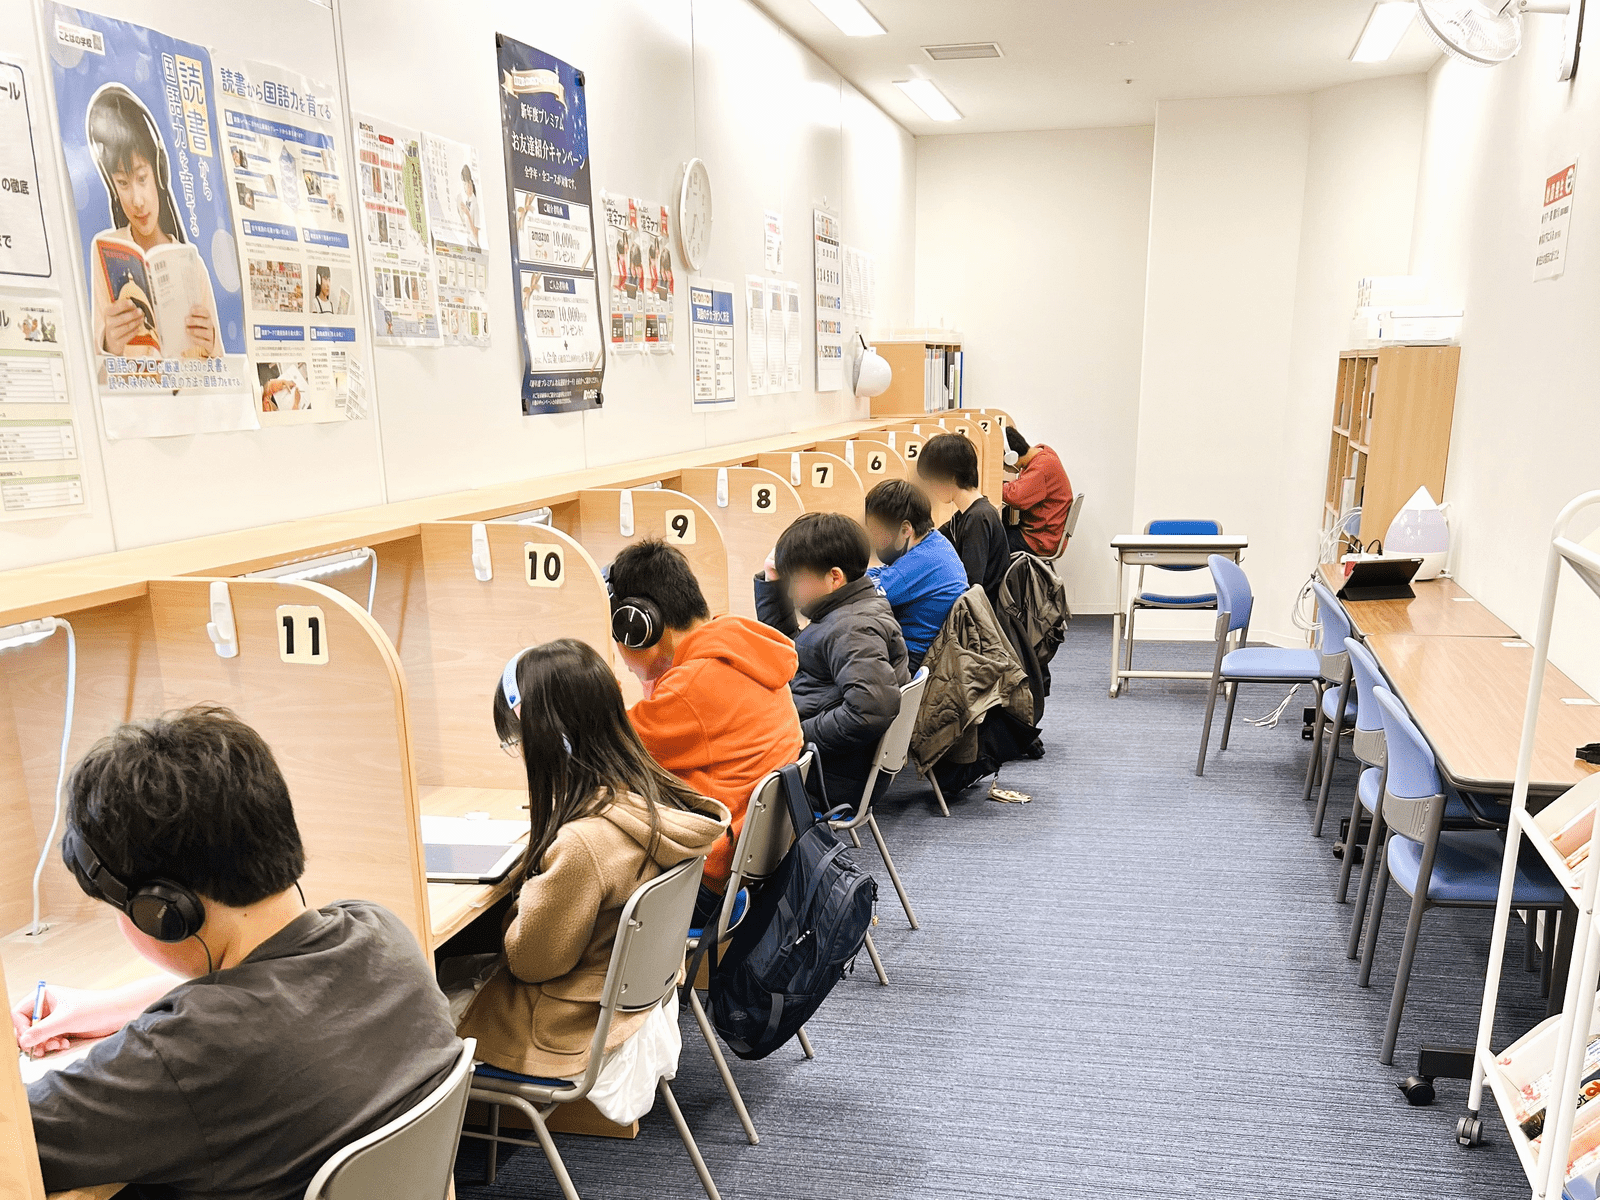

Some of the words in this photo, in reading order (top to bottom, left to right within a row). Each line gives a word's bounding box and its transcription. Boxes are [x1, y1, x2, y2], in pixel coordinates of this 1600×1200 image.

[220, 67, 332, 120] 読書から国語力を育てる
[520, 102, 565, 132] 新年度プレミアム
[161, 53, 200, 238] 国語力を育てる
[511, 131, 586, 170] お友達紹介キャンペーン
[2, 178, 30, 195] の徹底
[0, 235, 12, 249] で
[531, 231, 549, 243] amazon
[536, 308, 555, 319] amazon
[981, 422, 988, 432] 2
[908, 445, 918, 458] 5
[870, 455, 882, 471] 6
[816, 467, 829, 484] 7
[756, 488, 771, 509] 8
[671, 515, 689, 539] 9
[528, 550, 561, 581] 10
[282, 615, 320, 656] 11
